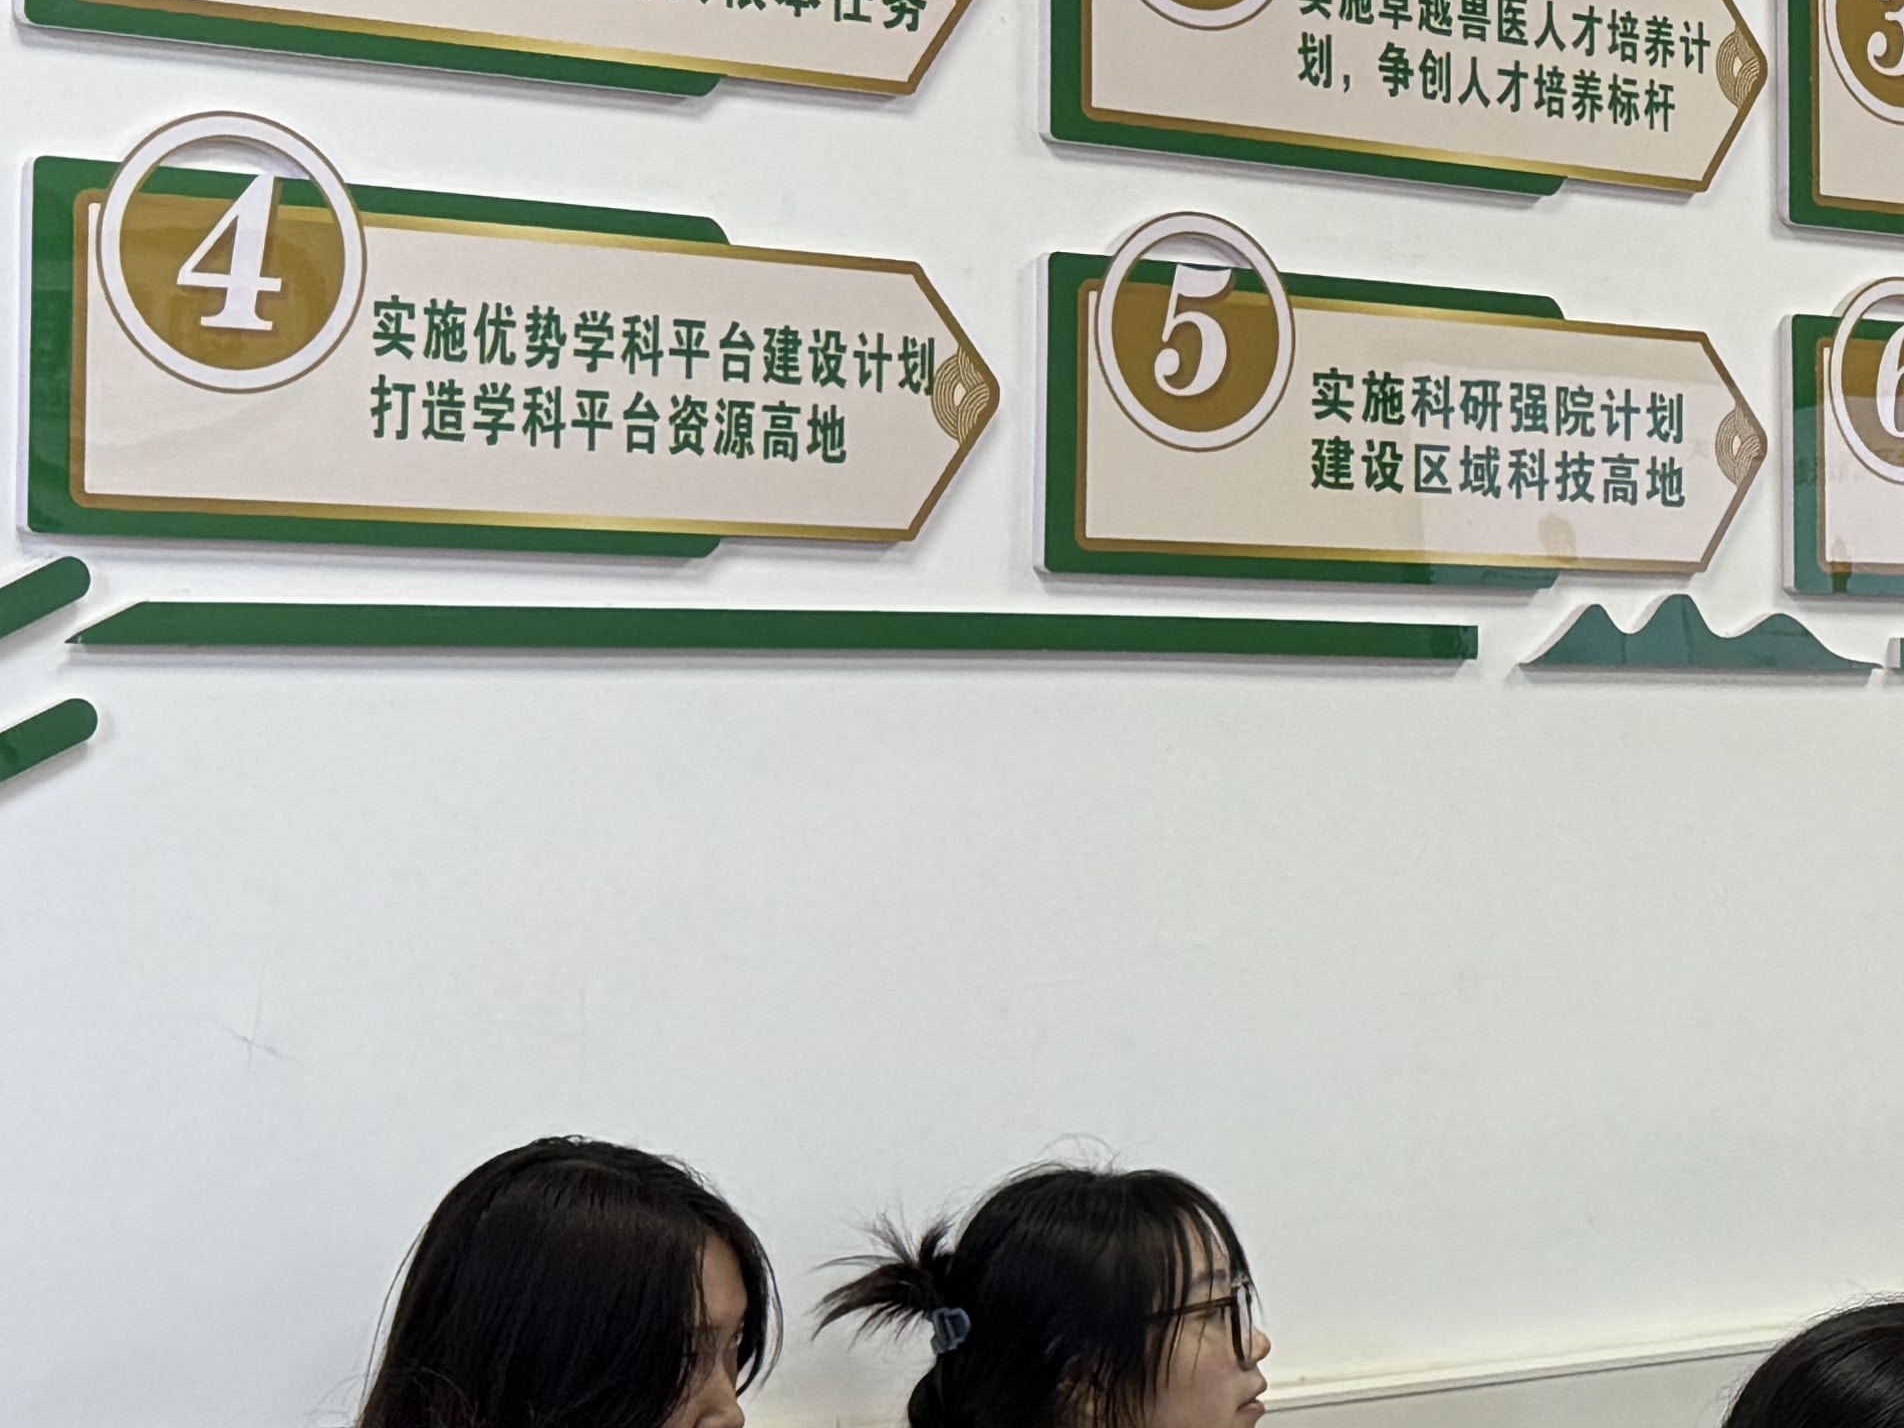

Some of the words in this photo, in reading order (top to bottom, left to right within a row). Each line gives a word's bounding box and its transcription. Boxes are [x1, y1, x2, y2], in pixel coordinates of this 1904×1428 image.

[1297, 32, 1676, 133] 划，争创人才培养标杆
[176, 173, 282, 332] 4
[372, 294, 936, 396] 实施优势学科平台建设计划
[1154, 264, 1232, 397] 5
[370, 373, 847, 465] 打造学科平台资源高地
[1310, 367, 1684, 444] 实施科研强院计划
[1310, 435, 1686, 508] 建设区域科技高地
